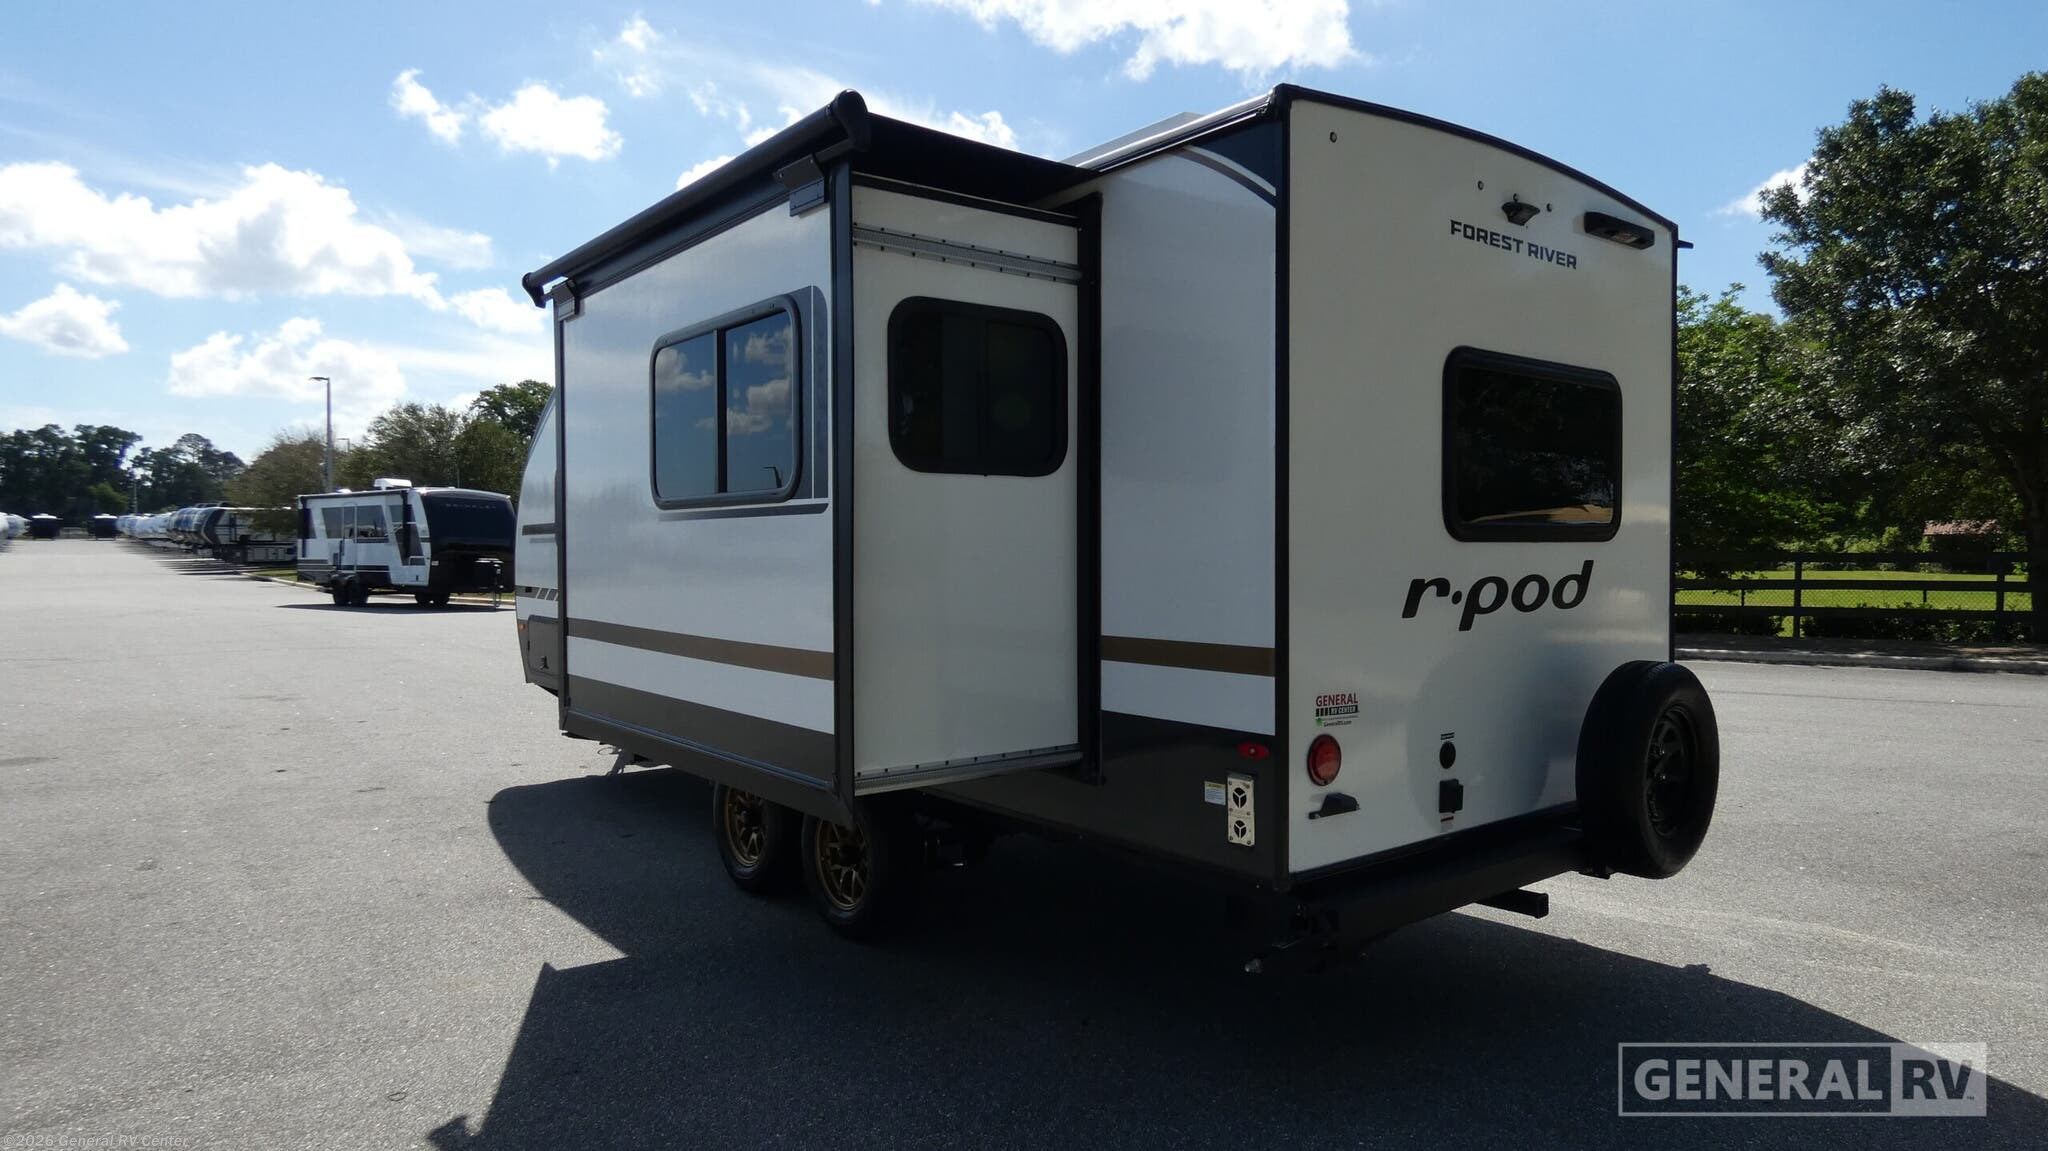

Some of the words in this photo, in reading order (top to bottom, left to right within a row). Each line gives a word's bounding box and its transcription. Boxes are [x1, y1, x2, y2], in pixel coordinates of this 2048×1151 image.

[1450, 219, 1524, 253] FOREST
[1527, 242, 1577, 269] RIVER
[1316, 692, 1358, 707] GENERAL
